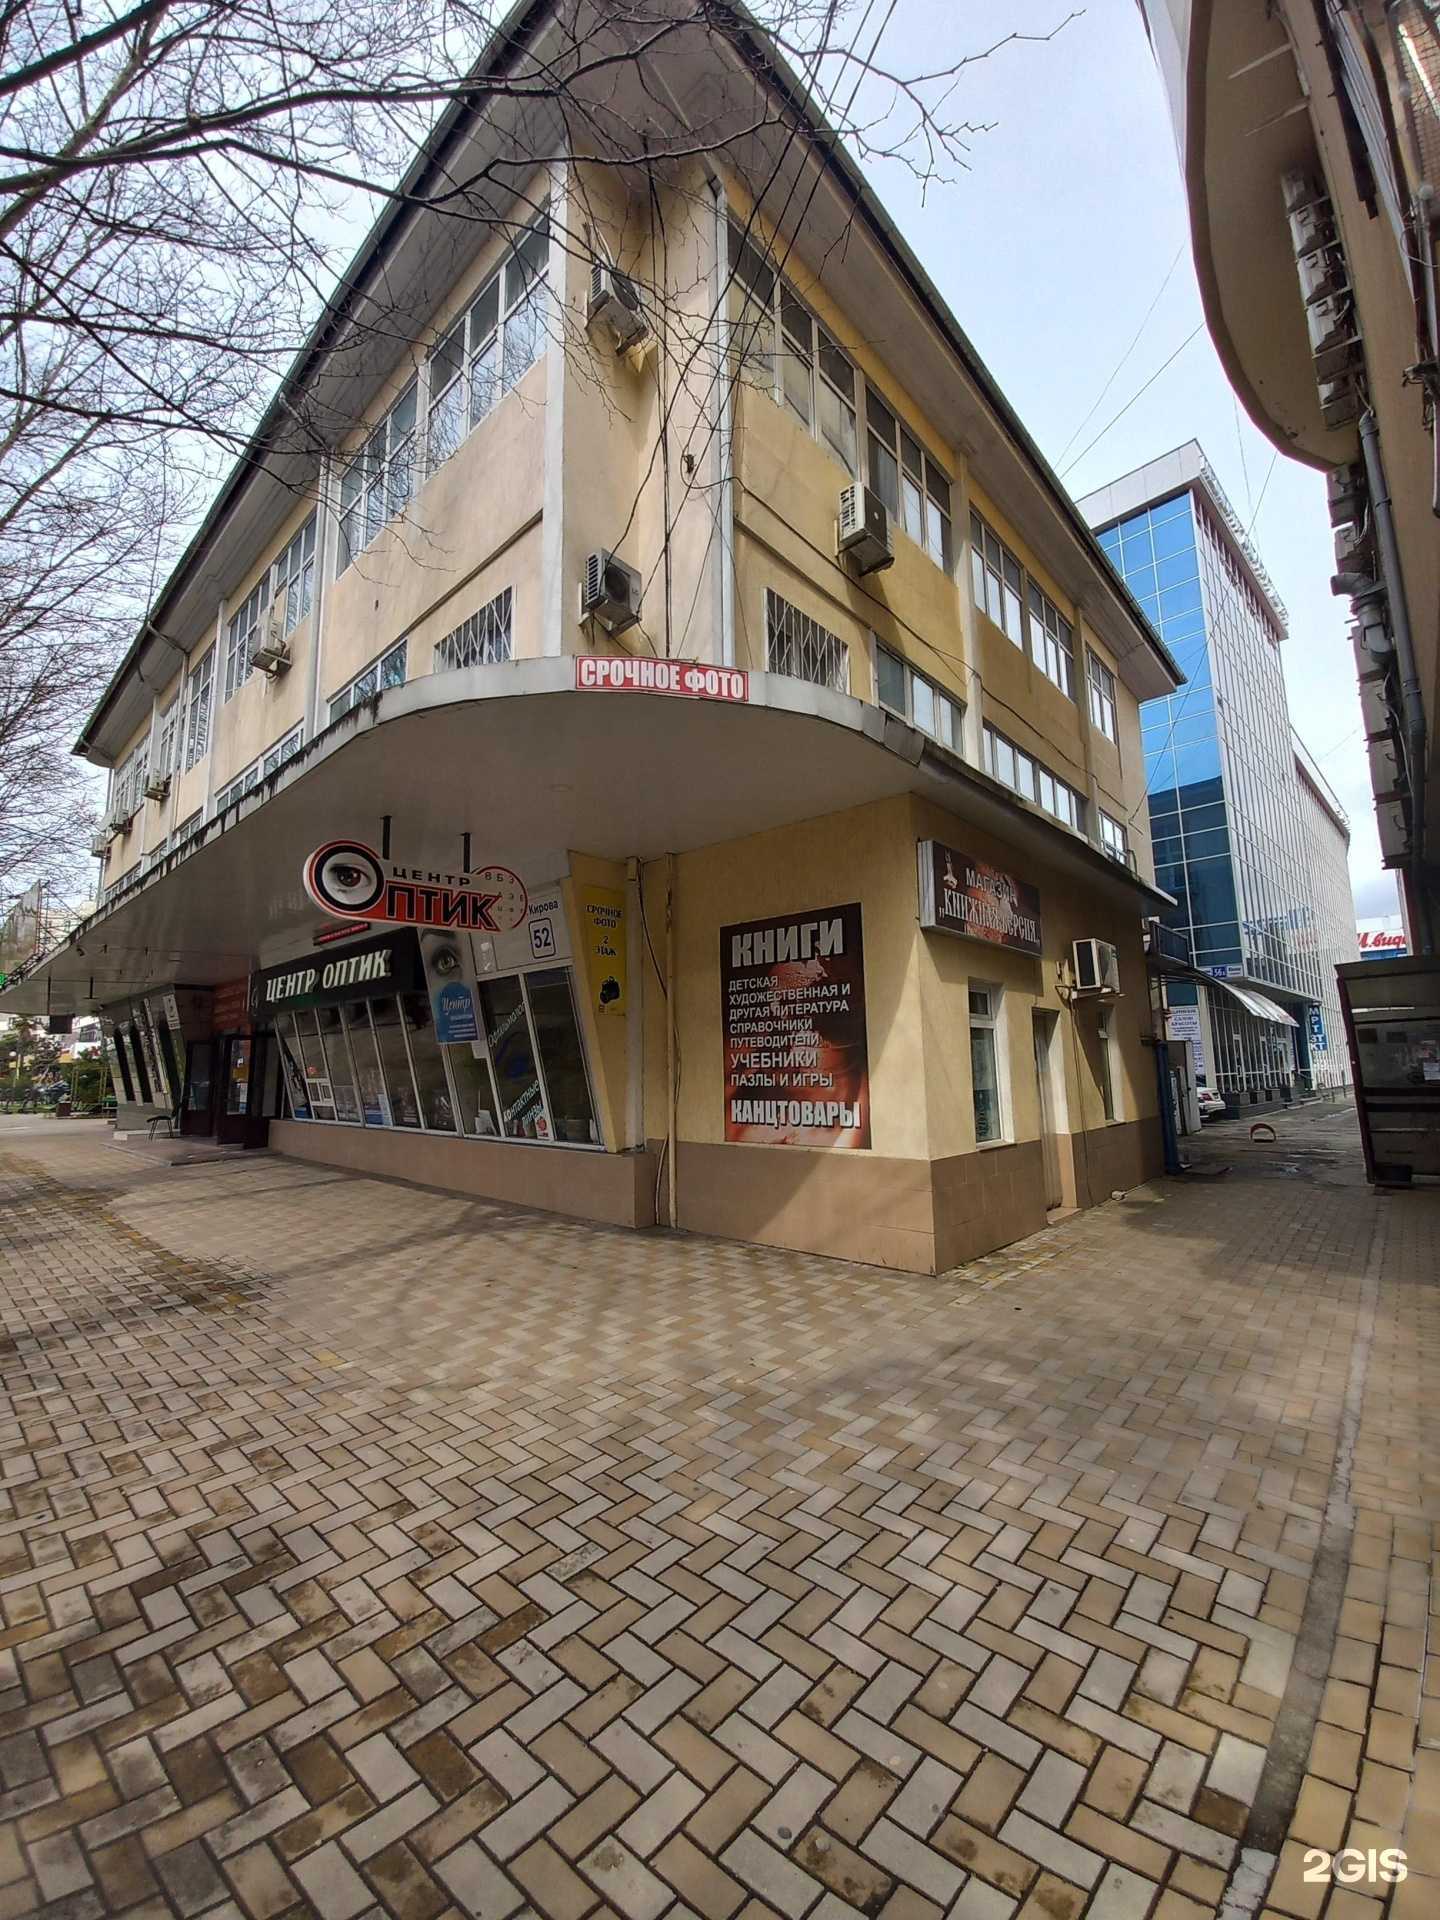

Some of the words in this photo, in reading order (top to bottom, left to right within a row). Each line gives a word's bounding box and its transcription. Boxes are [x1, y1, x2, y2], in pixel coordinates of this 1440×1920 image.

[580, 659, 680, 691] СРОЧНОЕ
[684, 669, 744, 699] ФОТО
[393, 866, 470, 887] ЦЕНТР
[966, 867, 1018, 907] МАГАЗИН
[528, 900, 559, 915] Кирова
[533, 927, 551, 948] 52
[604, 935, 609, 945] 2
[732, 918, 843, 968] КНИГИ
[266, 968, 317, 1002] ЦЕНТР
[322, 949, 392, 989] ОПТИК
[729, 975, 779, 993] ДЕТСКАЯ
[729, 984, 839, 1006] ХУДОЖЕСТВЕННАЯ
[841, 983, 851, 996] И
[730, 1005, 770, 1021] ДРУГАЯ
[772, 999, 850, 1017] ЛИТЕРАТУРА
[730, 1018, 813, 1035] СПРАВОЧНИКИ
[731, 1033, 819, 1049] ПУТЕВОДИТЕЛИ
[731, 1051, 818, 1069] УЧЕБНИКИ
[731, 1074, 776, 1087] ПАЗЛЫ
[780, 1074, 788, 1086] И
[793, 1073, 833, 1087] ИГРЫ
[731, 1100, 861, 1128] КАНЦТОВАРЫ
